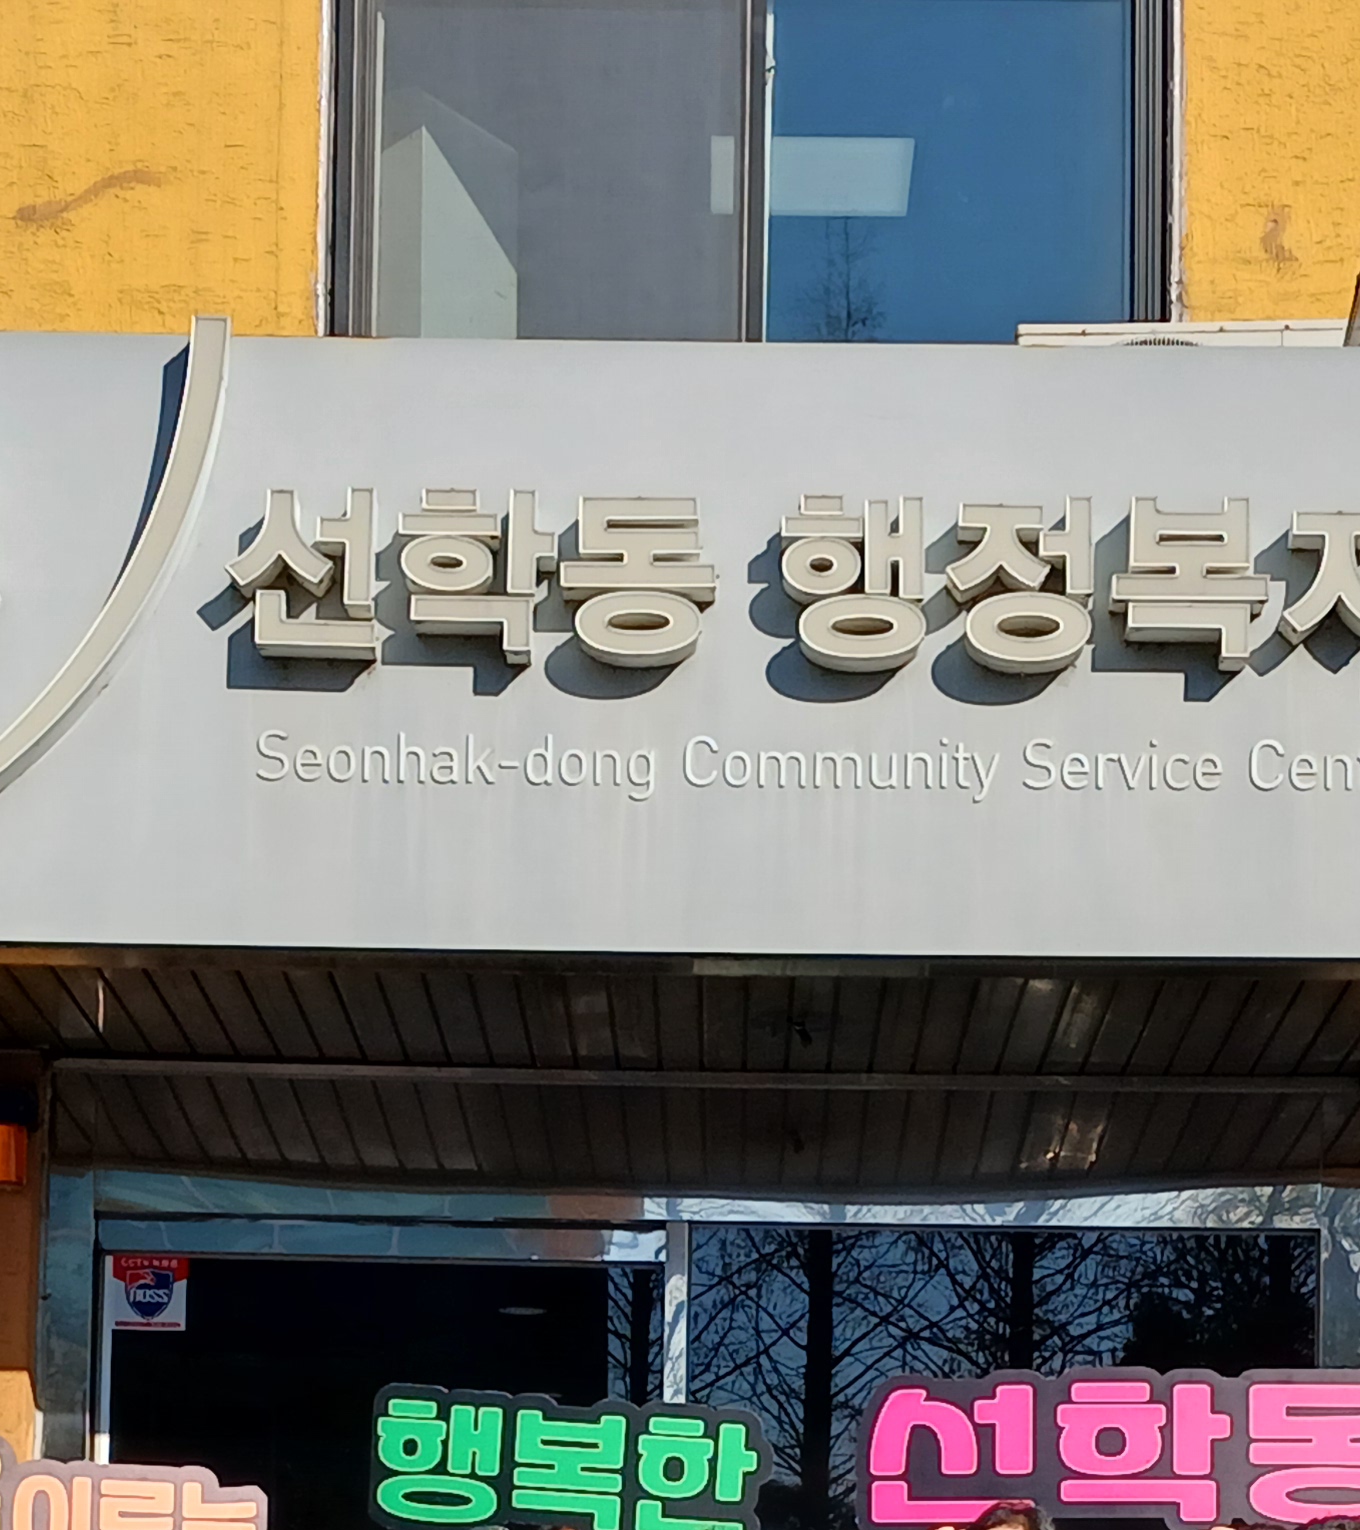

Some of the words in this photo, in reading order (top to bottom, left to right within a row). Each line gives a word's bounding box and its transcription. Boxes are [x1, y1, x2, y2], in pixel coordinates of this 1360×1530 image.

[227, 487, 718, 668] 선학동
[255, 728, 655, 801] Seonhak-dong
[683, 733, 1000, 803] Community
[1023, 736, 1224, 793] Service
